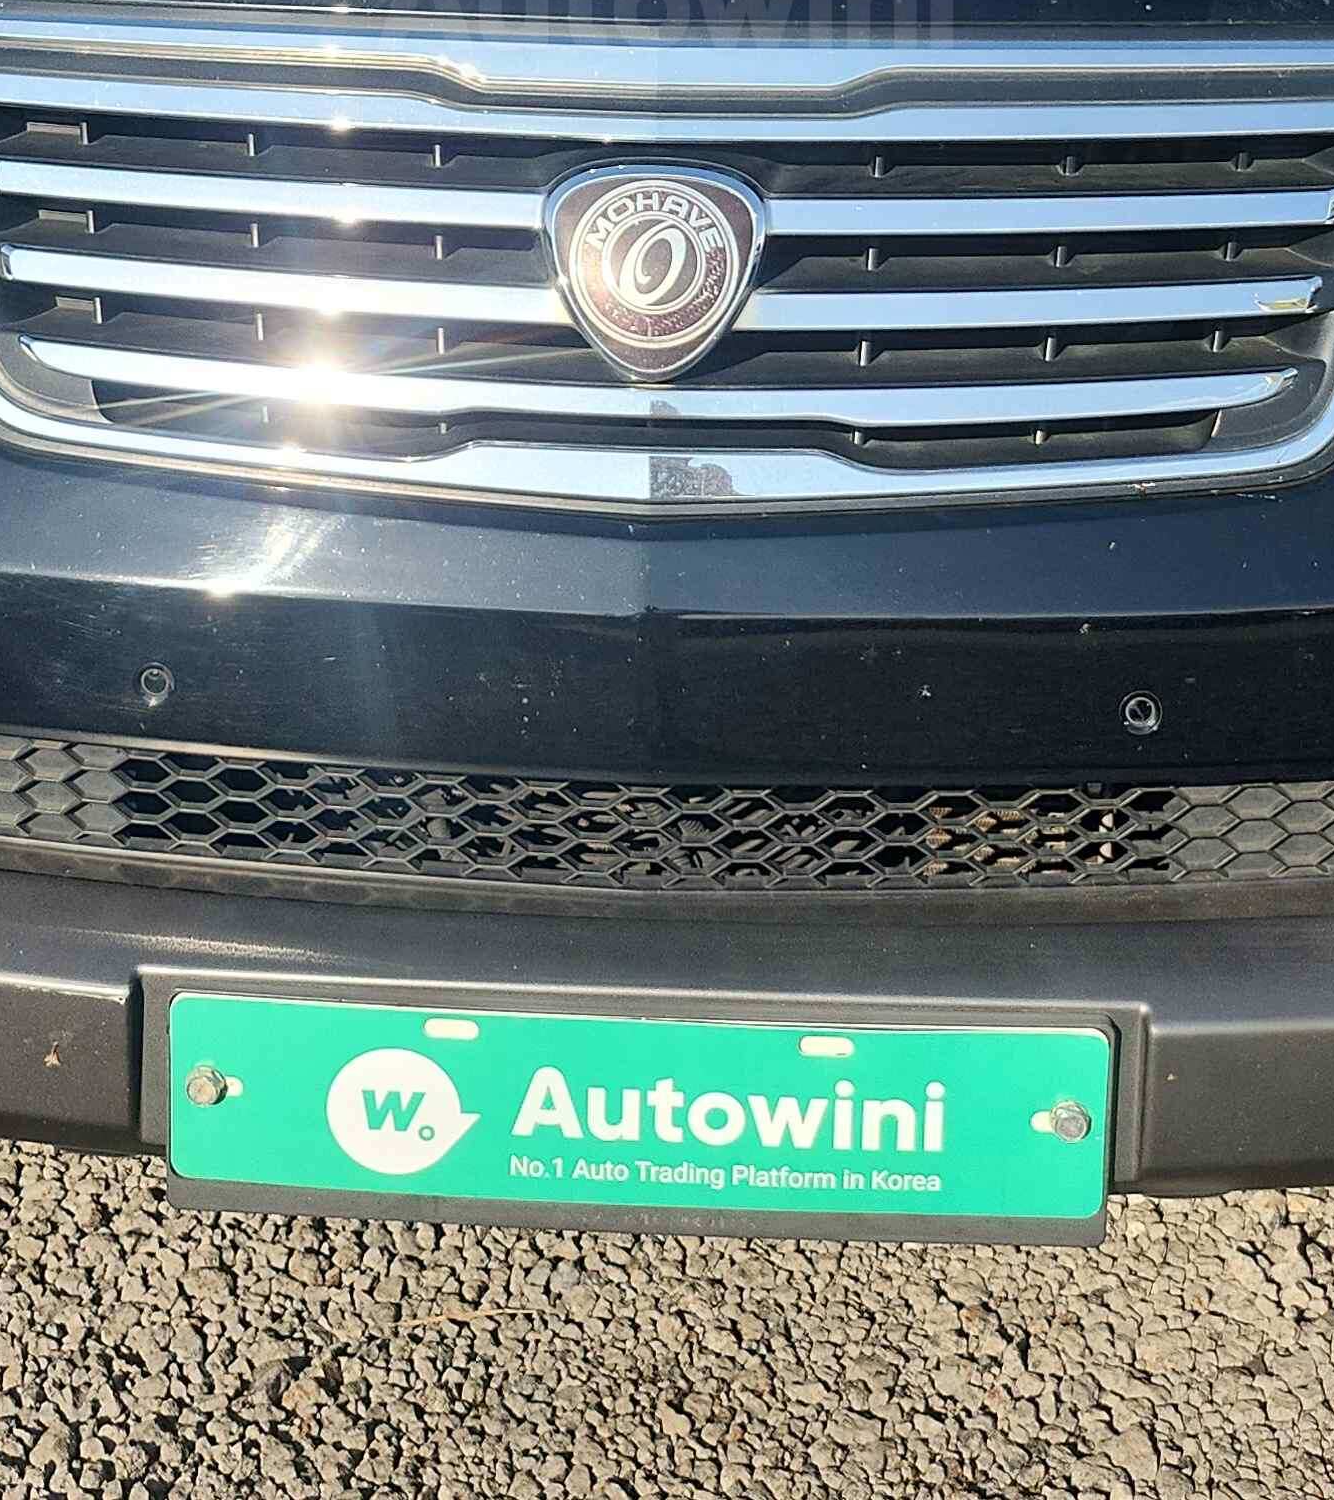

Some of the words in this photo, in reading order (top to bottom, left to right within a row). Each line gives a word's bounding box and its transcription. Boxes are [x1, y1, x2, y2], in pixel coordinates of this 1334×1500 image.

[586, 192, 723, 251] MOHAVE
[511, 1065, 945, 1152] Autowini
[509, 1155, 563, 1178] No.1
[572, 1158, 628, 1182] Auto
[635, 1161, 725, 1189] Trading
[731, 1165, 836, 1190] Platform
[843, 1169, 864, 1190] in
[871, 1171, 940, 1192] Korea
